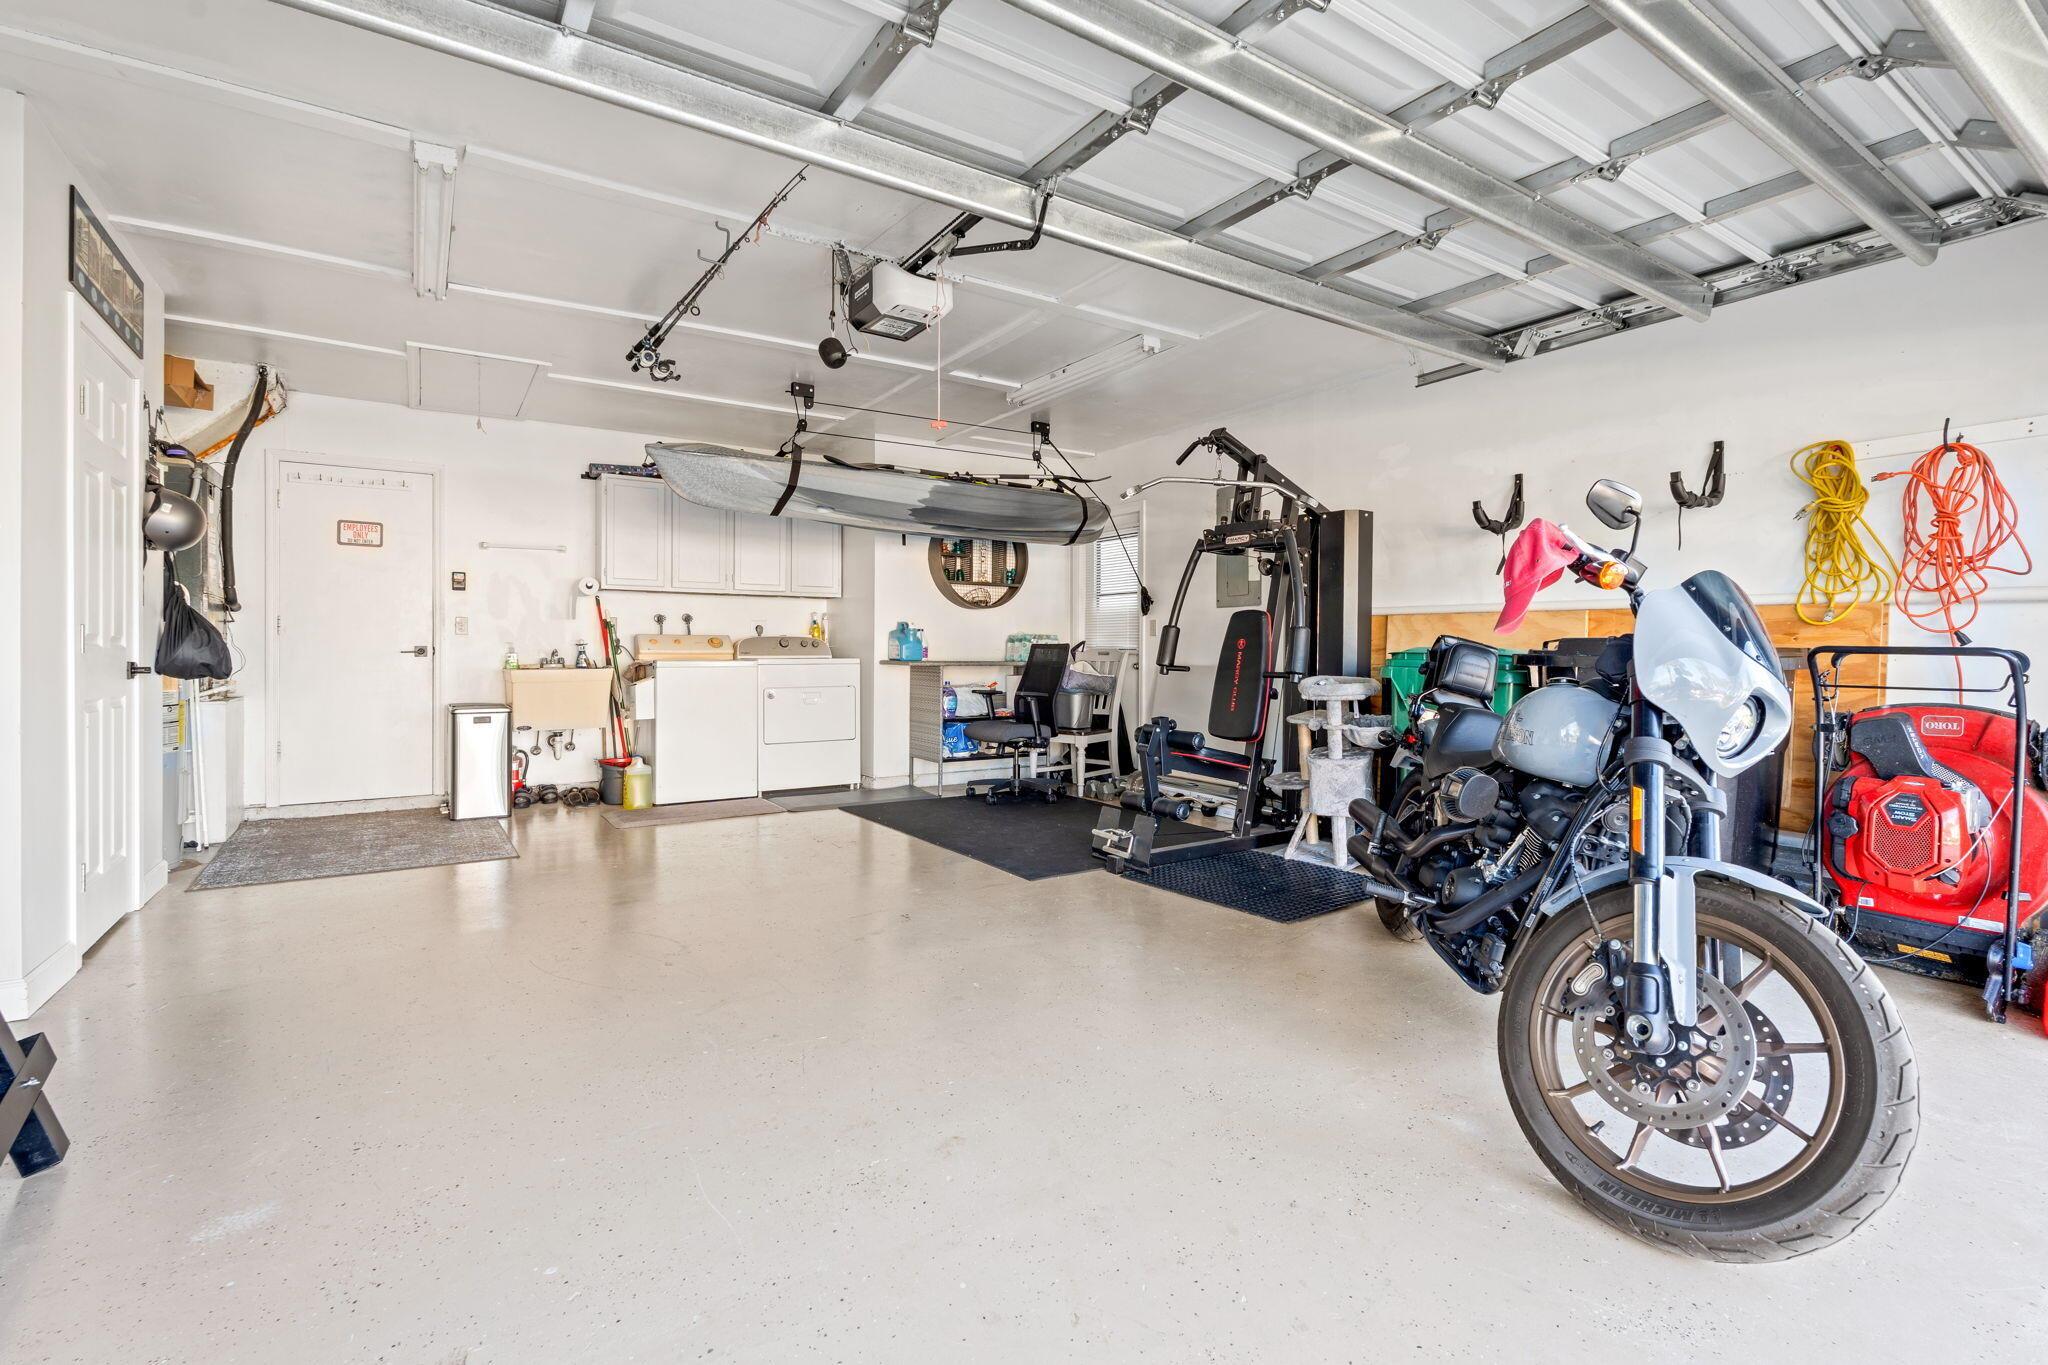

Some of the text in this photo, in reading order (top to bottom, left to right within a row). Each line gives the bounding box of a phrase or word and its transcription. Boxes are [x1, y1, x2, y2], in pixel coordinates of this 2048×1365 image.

[343, 523, 379, 532] EMPLOYEES
[352, 531, 369, 539] ONLY
[1233, 651, 1243, 685] MARCY
[1925, 721, 1960, 730] TORO
[1597, 1179, 1694, 1223] MICHELIN
